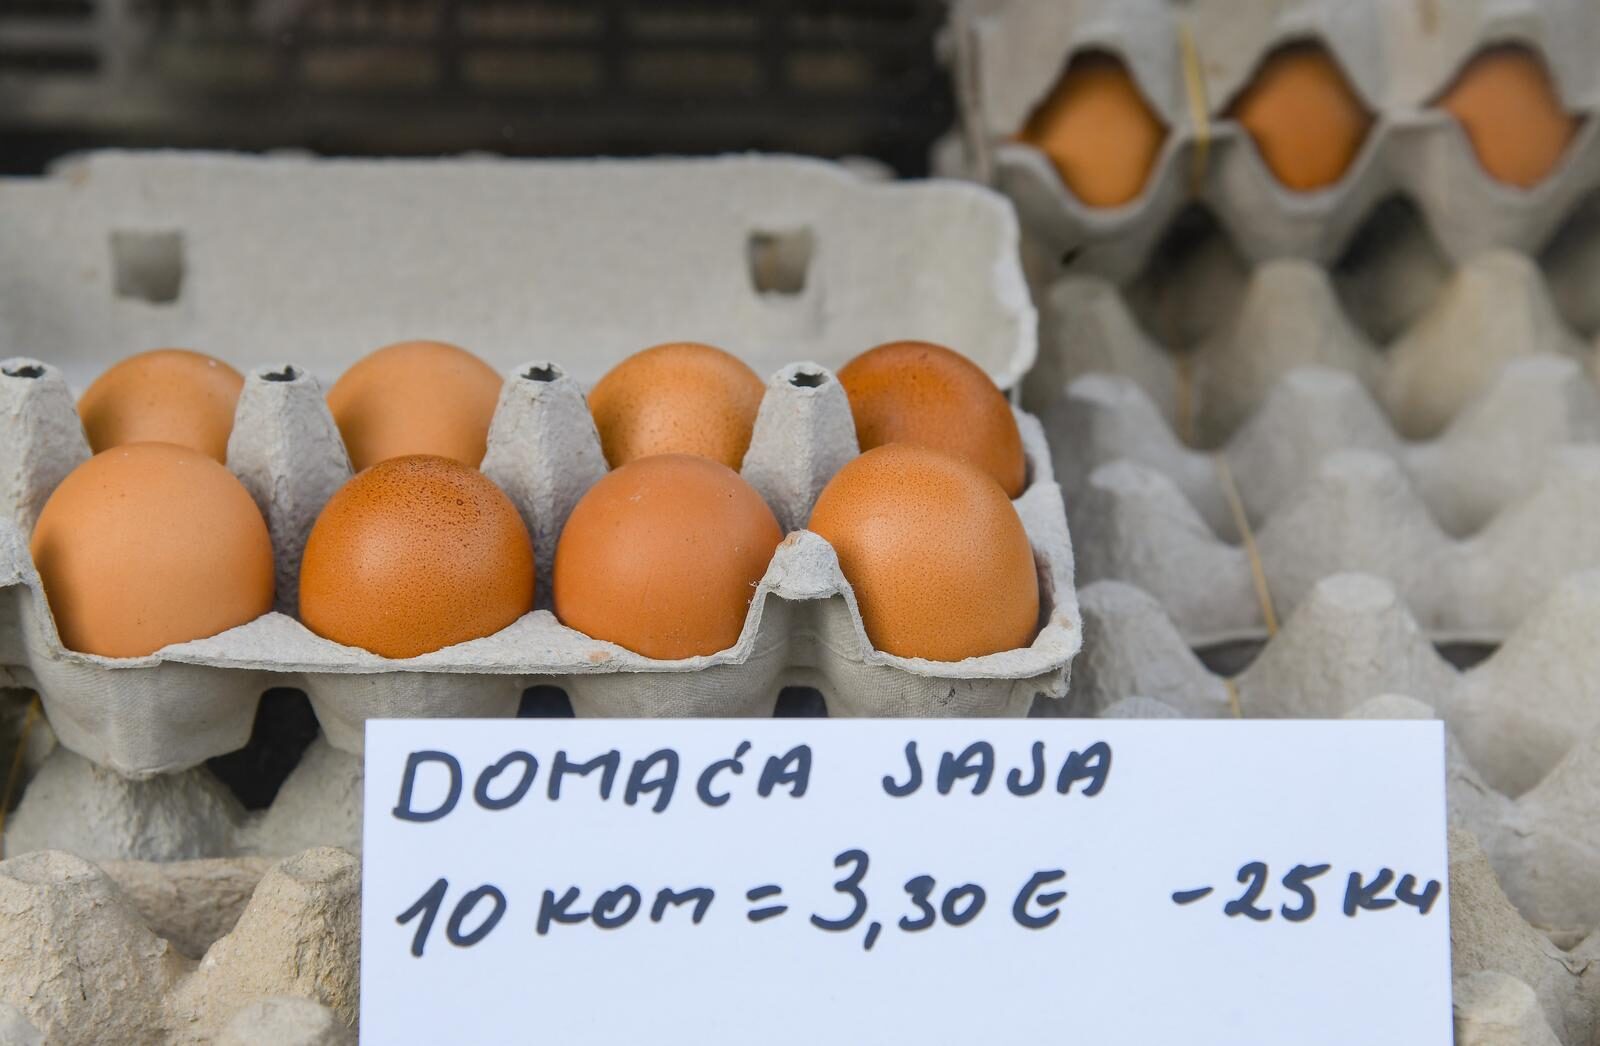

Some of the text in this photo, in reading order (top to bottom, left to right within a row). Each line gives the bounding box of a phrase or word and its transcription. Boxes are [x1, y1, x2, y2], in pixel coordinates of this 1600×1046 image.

[392, 740, 1112, 823] DOMAĆA JAJA
[395, 877, 507, 958] 10
[745, 884, 789, 923] =
[809, 848, 987, 951] 3,30
